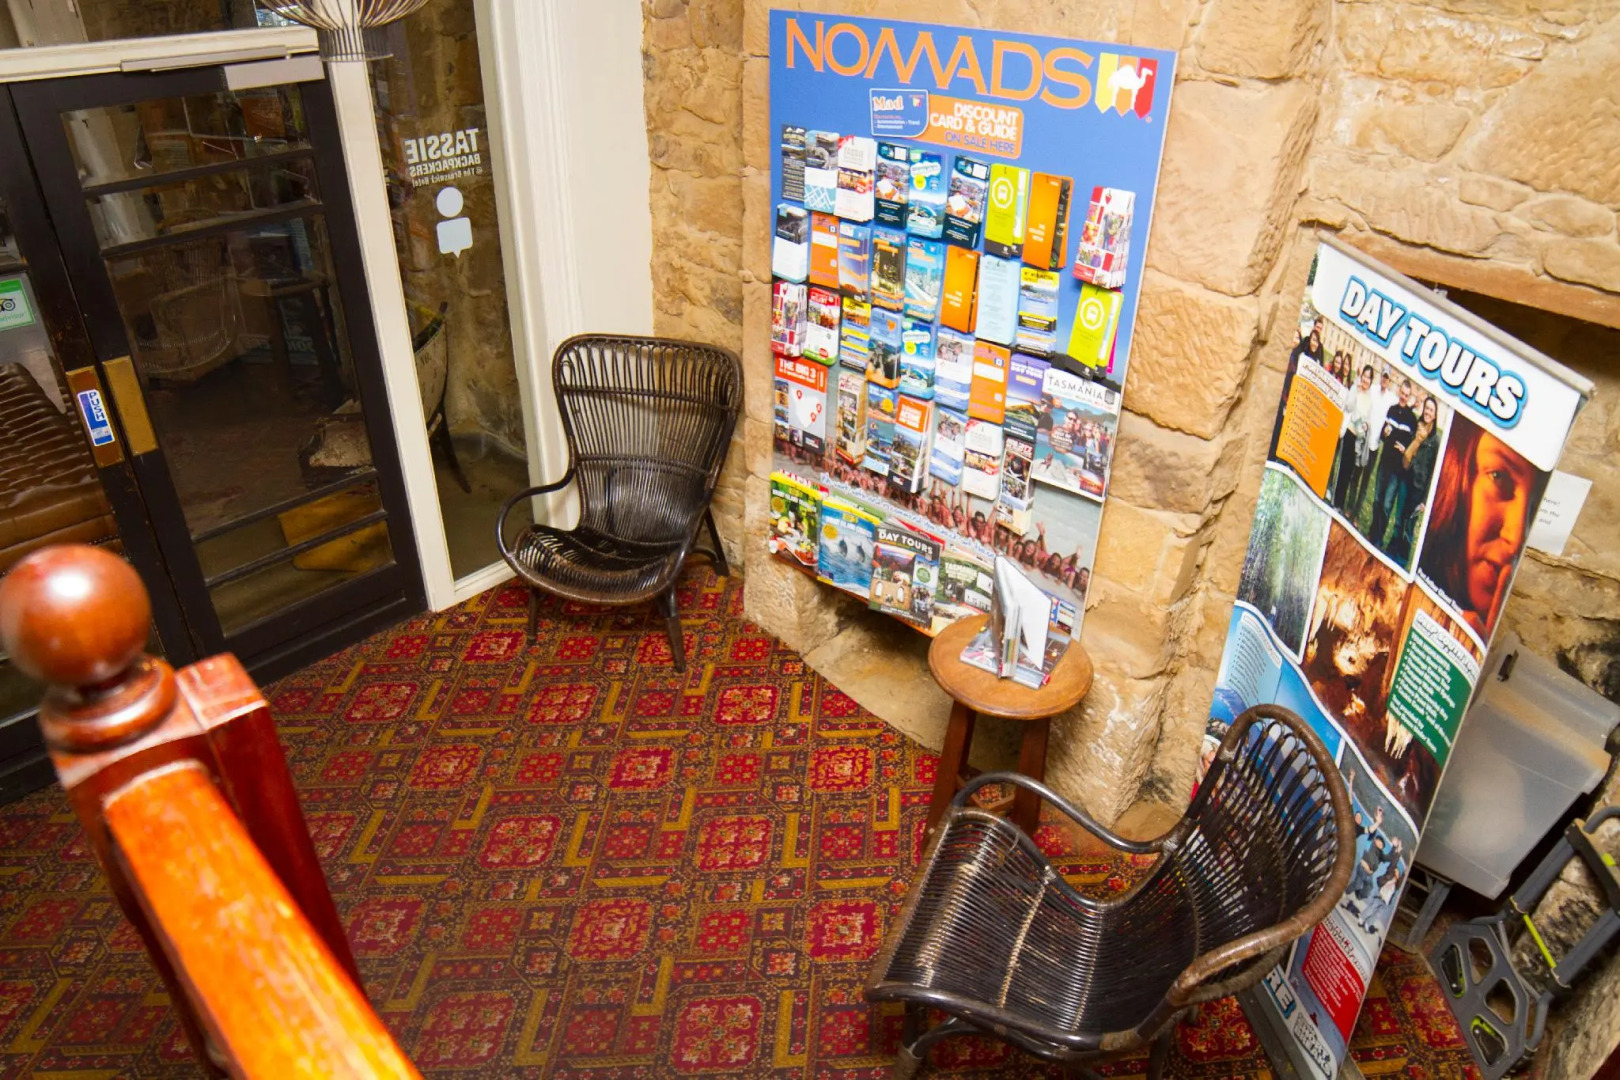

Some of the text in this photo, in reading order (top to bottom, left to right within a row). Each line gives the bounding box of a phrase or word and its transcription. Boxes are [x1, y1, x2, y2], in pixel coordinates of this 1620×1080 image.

[786, 18, 1094, 110] NOMADS
[954, 102, 1018, 122] DISCOUNT
[930, 113, 1017, 140] CARD & GUIDE
[945, 131, 1015, 154] ON SALE HERE
[1341, 277, 1406, 345] DAY
[1402, 314, 1526, 426] TOURS
[779, 358, 796, 371] THE
[809, 368, 816, 379] 3
[1048, 374, 1103, 400] TASMANIA
[90, 391, 105, 420] PUSH
[879, 529, 933, 555] DAY TOURS
